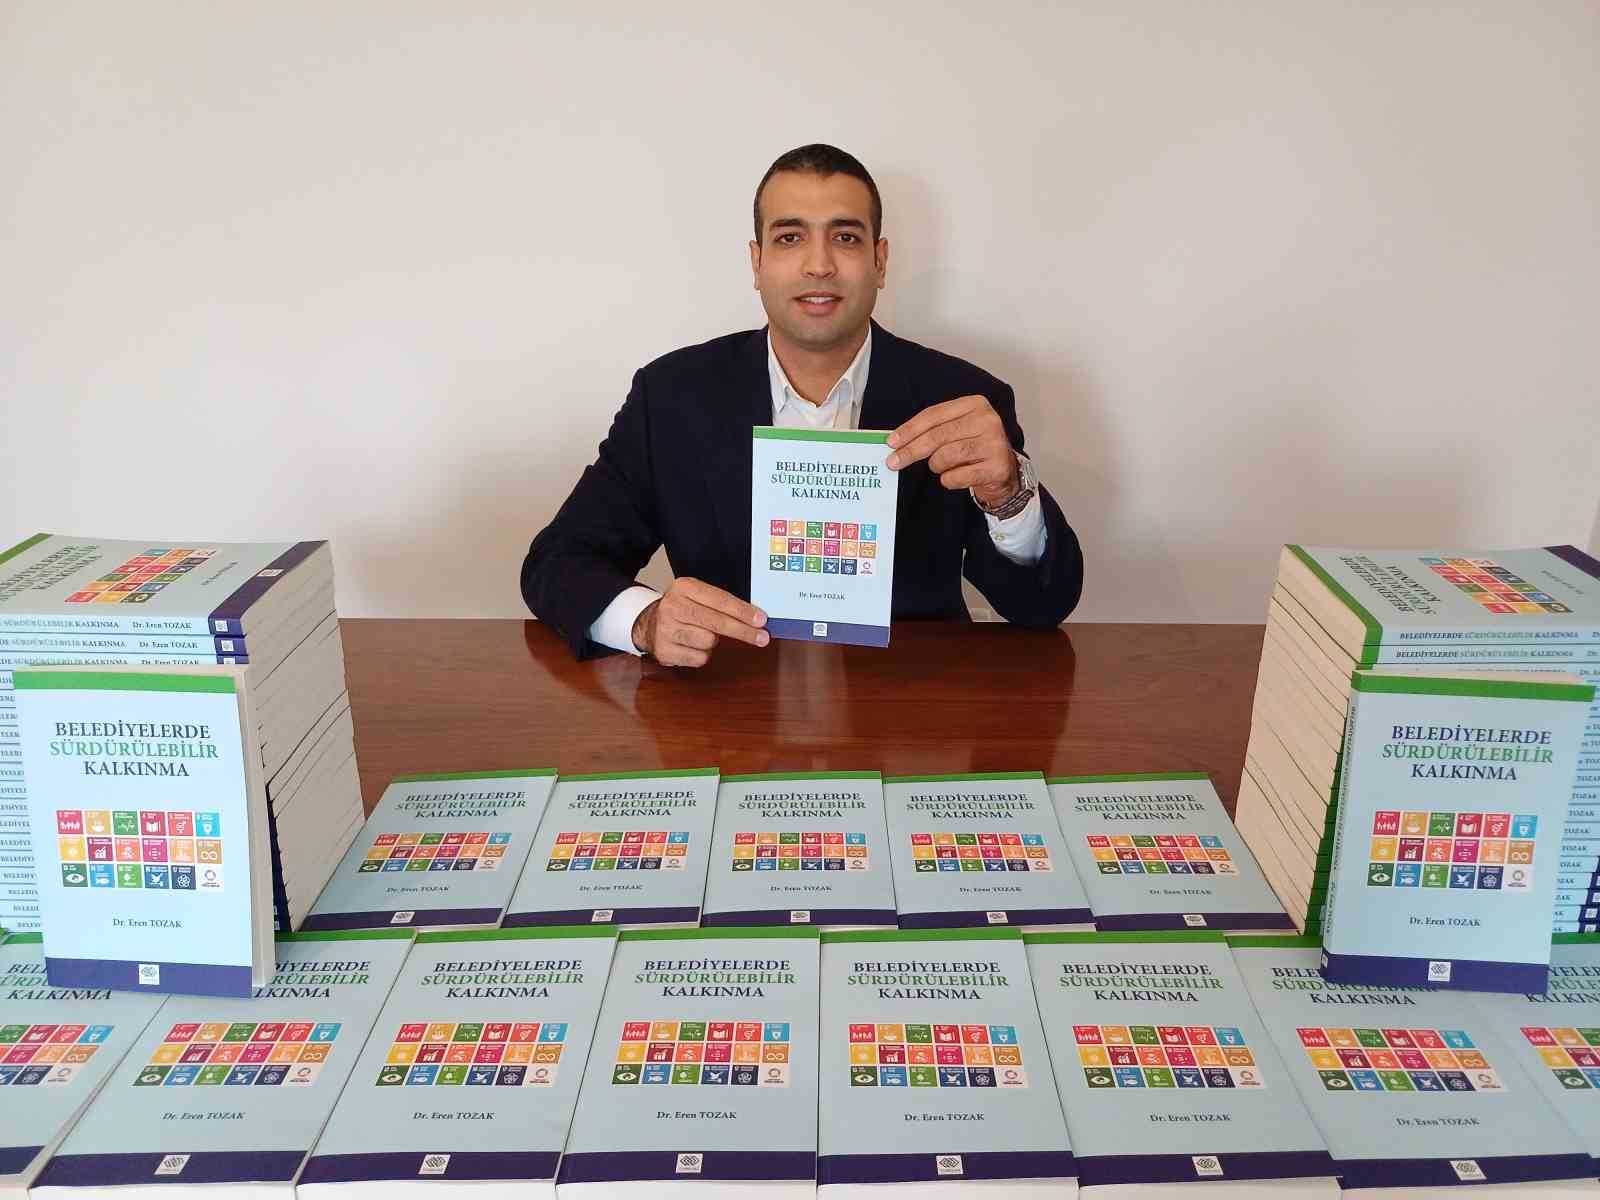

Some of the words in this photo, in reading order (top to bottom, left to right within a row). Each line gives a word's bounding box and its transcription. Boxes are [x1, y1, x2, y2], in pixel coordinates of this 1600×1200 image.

[776, 460, 879, 476] BELEDİYELERDE
[770, 473, 882, 488] SÜRDÜRÜLEBİLİR
[791, 488, 860, 500] KALKINMA
[56, 720, 210, 739] BELEDİYELERDE
[1392, 724, 1552, 745] BELEDİYELERDE
[50, 740, 218, 760] SÜRDÜRÜLEBİLİR
[1382, 743, 1553, 764] SÜRDÜRÜLEBİLİR
[84, 761, 190, 777] KALKINMA
[1412, 764, 1517, 781] KALKINMA
[406, 791, 527, 802] BELEDİYELERDE
[576, 790, 695, 801] BELEDİYELERDE
[744, 792, 861, 802] BELEDİYELERDE
[910, 793, 1028, 802] BELEDİYELERDE
[1076, 794, 1195, 804] BELEDİYELERDE
[395, 799, 527, 810] SÜRDÜRÜLEBİLİR
[568, 798, 697, 809] SÜRDÜRÜLEBİLİR
[738, 800, 866, 810] SÜRDÜRÜLEBİLİR
[906, 801, 1035, 811] SÜRDÜRÜLEBİLİR
[1074, 802, 1206, 812] SÜRDÜRÜLEBİLİR
[415, 808, 499, 818] KALKINMA
[590, 808, 672, 817] KALKINMA
[761, 808, 842, 818] KALKINMA
[932, 810, 1014, 819] KALKINMA
[1103, 811, 1187, 820] KALKINMA
[112, 918, 126, 928] Dr.
[128, 919, 148, 928] Eren
[150, 920, 182, 928] TOZAK
[1410, 916, 1422, 926] Dr.
[1426, 917, 1446, 926] Eren
[1447, 918, 1480, 927] TOZAK
[433, 959, 583, 973] BELEDİYELERDE
[644, 958, 791, 971] BELEDİYELERDE
[854, 960, 1001, 974] BELEDİYELERDE
[1063, 962, 1212, 976] BELEDİYELERDE
[271, 973, 369, 985] RÜLEBİLİR
[421, 972, 584, 986] SÜRDÜRÜLEBİLİR
[634, 971, 795, 984] SÜRDÜRÜLEBİLİR
[848, 974, 1009, 986] SÜRDÜRÜLEBİLİR
[1060, 976, 1223, 990] SÜRDÜRÜLEBİLİR
[8, 989, 111, 1000] KALKINMA
[254, 987, 330, 998] LKINMA
[446, 987, 550, 998] KALKINMA
[662, 986, 764, 997] KALKINMA
[879, 988, 982, 1000] KALKINMA
[1094, 989, 1199, 1002] KALKINMA
[1310, 993, 1416, 1005] KALKINMA
[1526, 993, 1600, 1003] KALKIN
[162, 1112, 178, 1120] Dr.
[181, 1112, 204, 1120] Eren
[206, 1112, 245, 1120] TOZAK
[413, 1111, 429, 1120] Dr.
[431, 1111, 454, 1120] Eren
[456, 1111, 495, 1120] TOZAK
[656, 1110, 672, 1120] Dr.
[674, 1110, 697, 1120] Eren
[700, 1110, 737, 1120] TOZAK
[904, 1113, 920, 1121] Dr.
[922, 1113, 944, 1121] Eren
[946, 1113, 985, 1121] TOZAK
[1150, 1113, 1166, 1122] Dr.
[1168, 1113, 1190, 1122] Eren
[1192, 1113, 1232, 1122] TOZAK
[1396, 1118, 1414, 1127] Dr.
[1439, 1118, 1480, 1127] TOZAK
